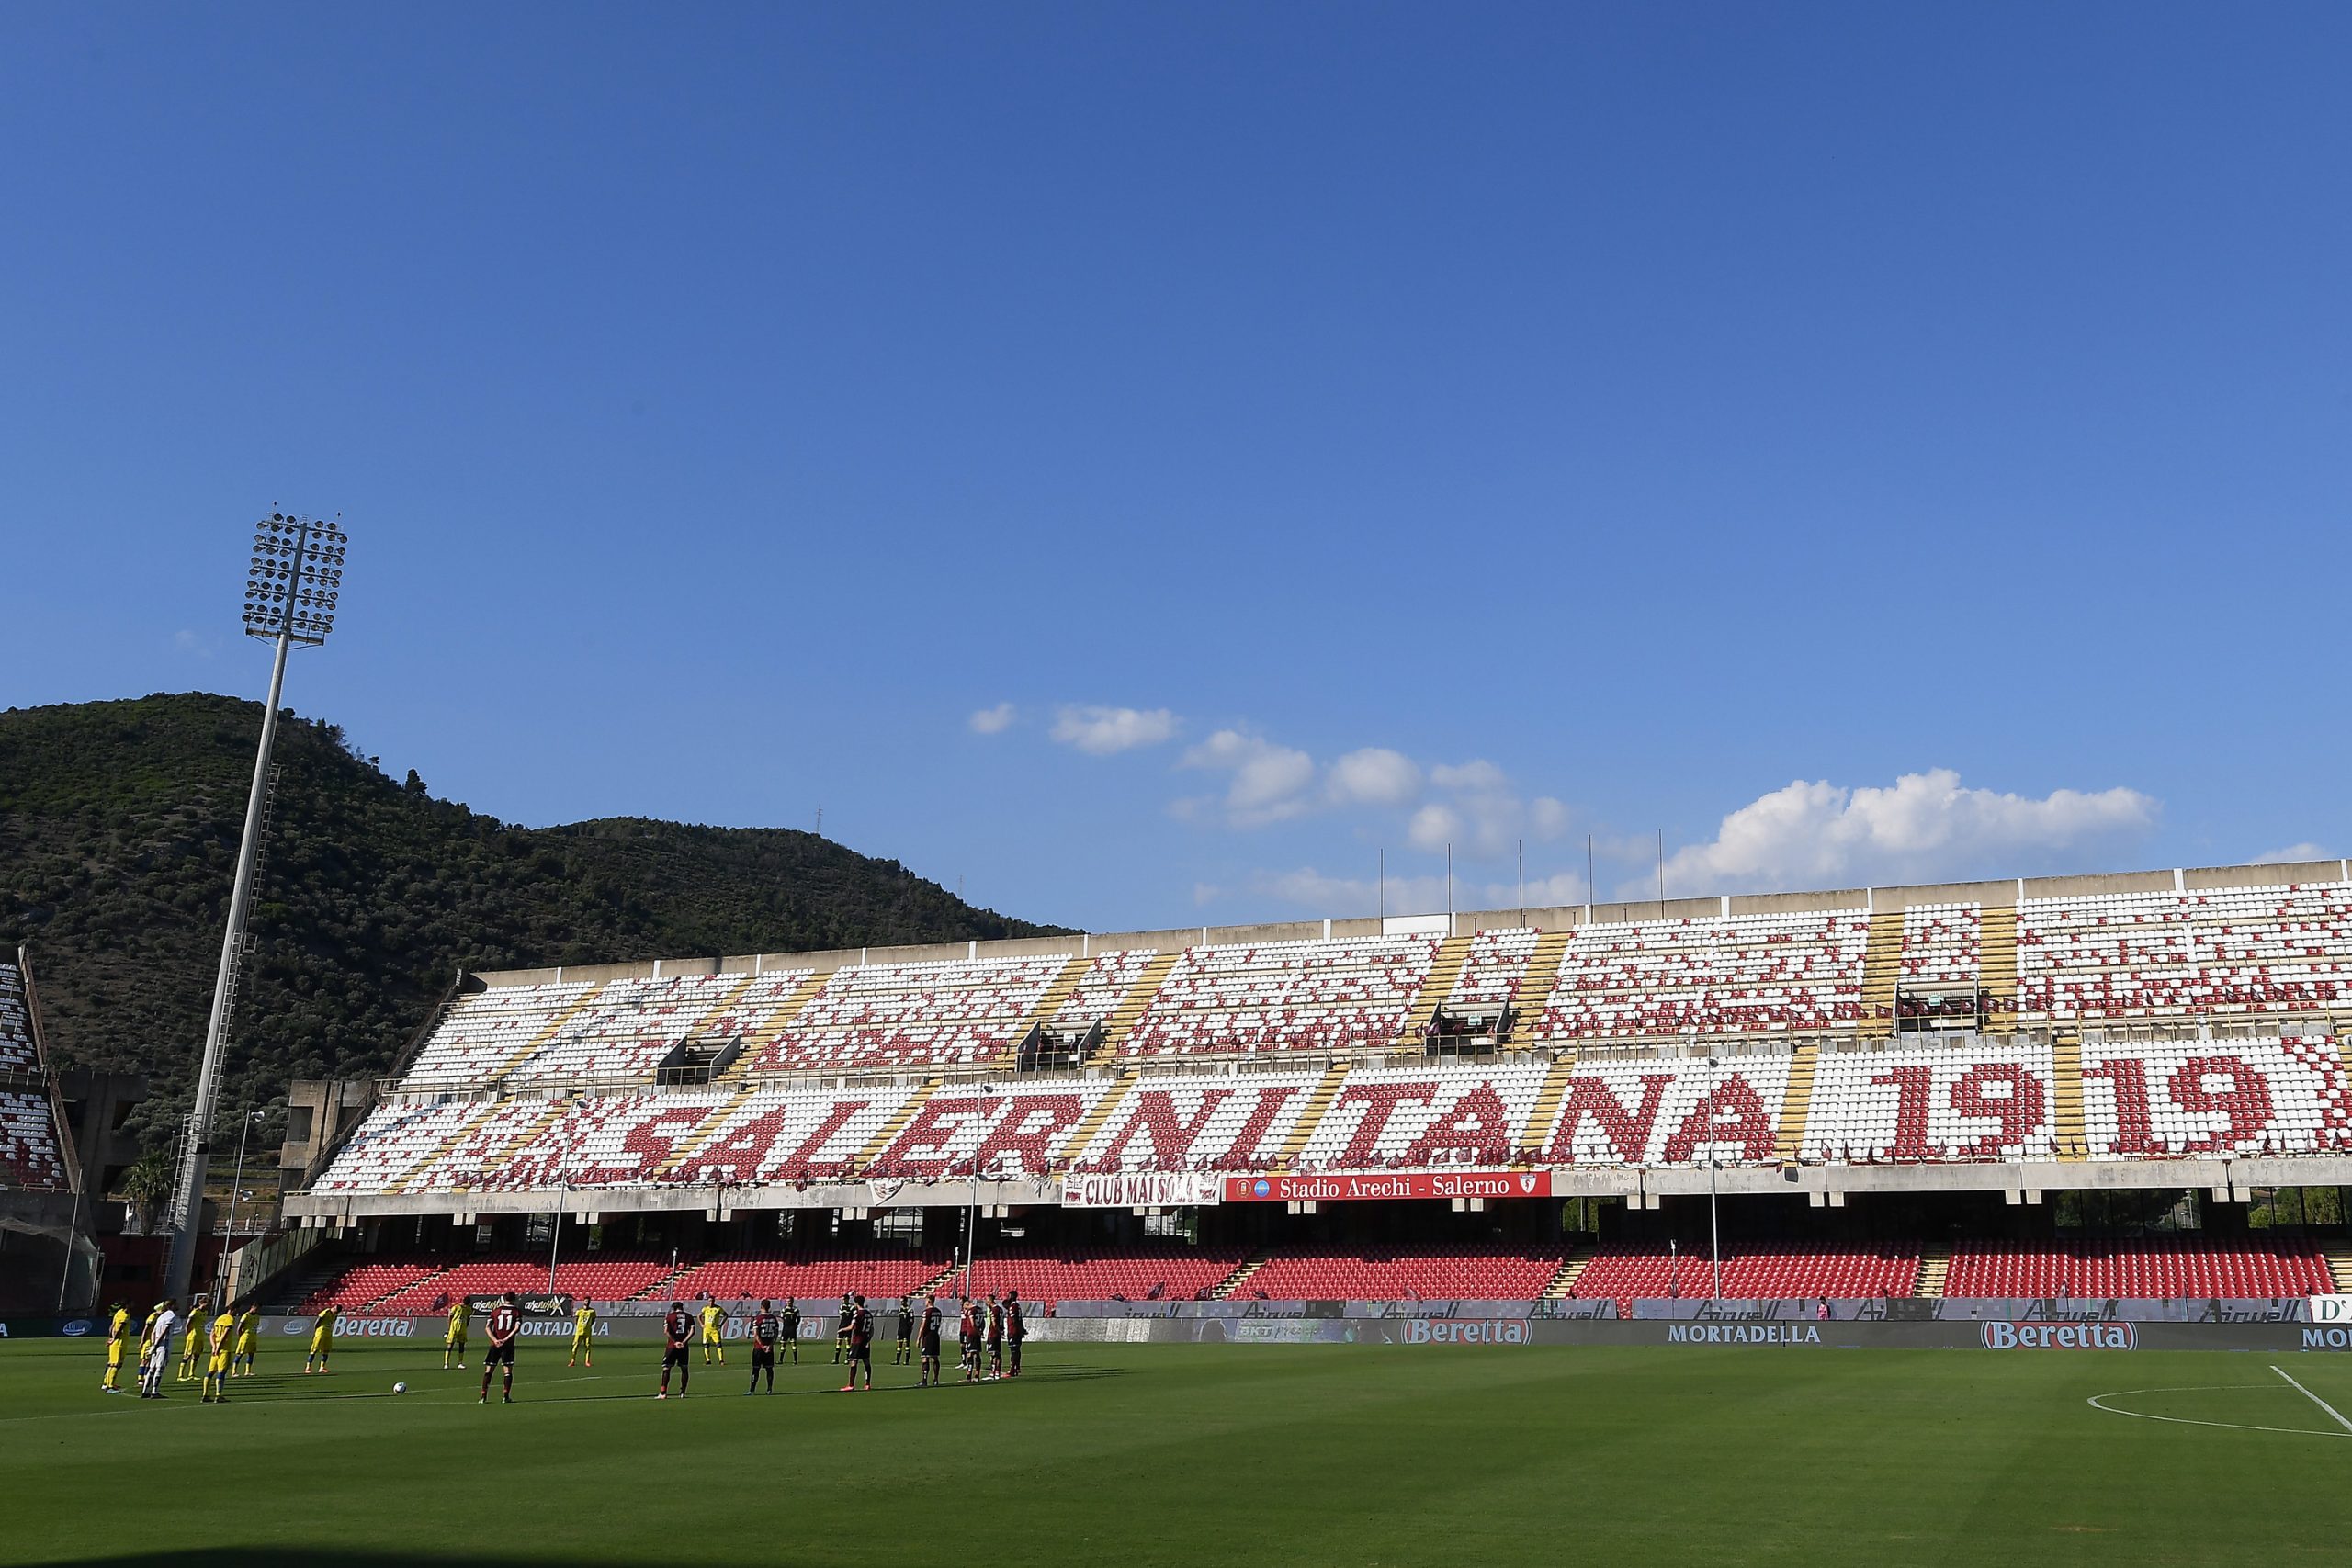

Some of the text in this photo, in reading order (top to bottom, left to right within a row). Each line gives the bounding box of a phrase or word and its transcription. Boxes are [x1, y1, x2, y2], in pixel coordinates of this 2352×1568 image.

[1871, 1055, 2278, 1161] 1919
[1085, 1176, 1123, 1206] CLUB
[1126, 1176, 1154, 1205] MAI
[1279, 1178, 1340, 1199] Stadio
[1346, 1177, 1411, 1198] Arechi
[1432, 1175, 1510, 1196] Salerno
[1693, 1300, 1781, 1321] Airwell
[332, 1316, 409, 1337] Beretta
[497, 1314, 513, 1331] 11
[515, 1321, 609, 1336] ORTADLA
[676, 1318, 686, 1334] 3
[1409, 1318, 1522, 1344] Beretta
[1668, 1325, 1821, 1343] MORTADELLA
[1991, 1321, 2129, 1348] Beretta
[2301, 1328, 2352, 1348] MO
